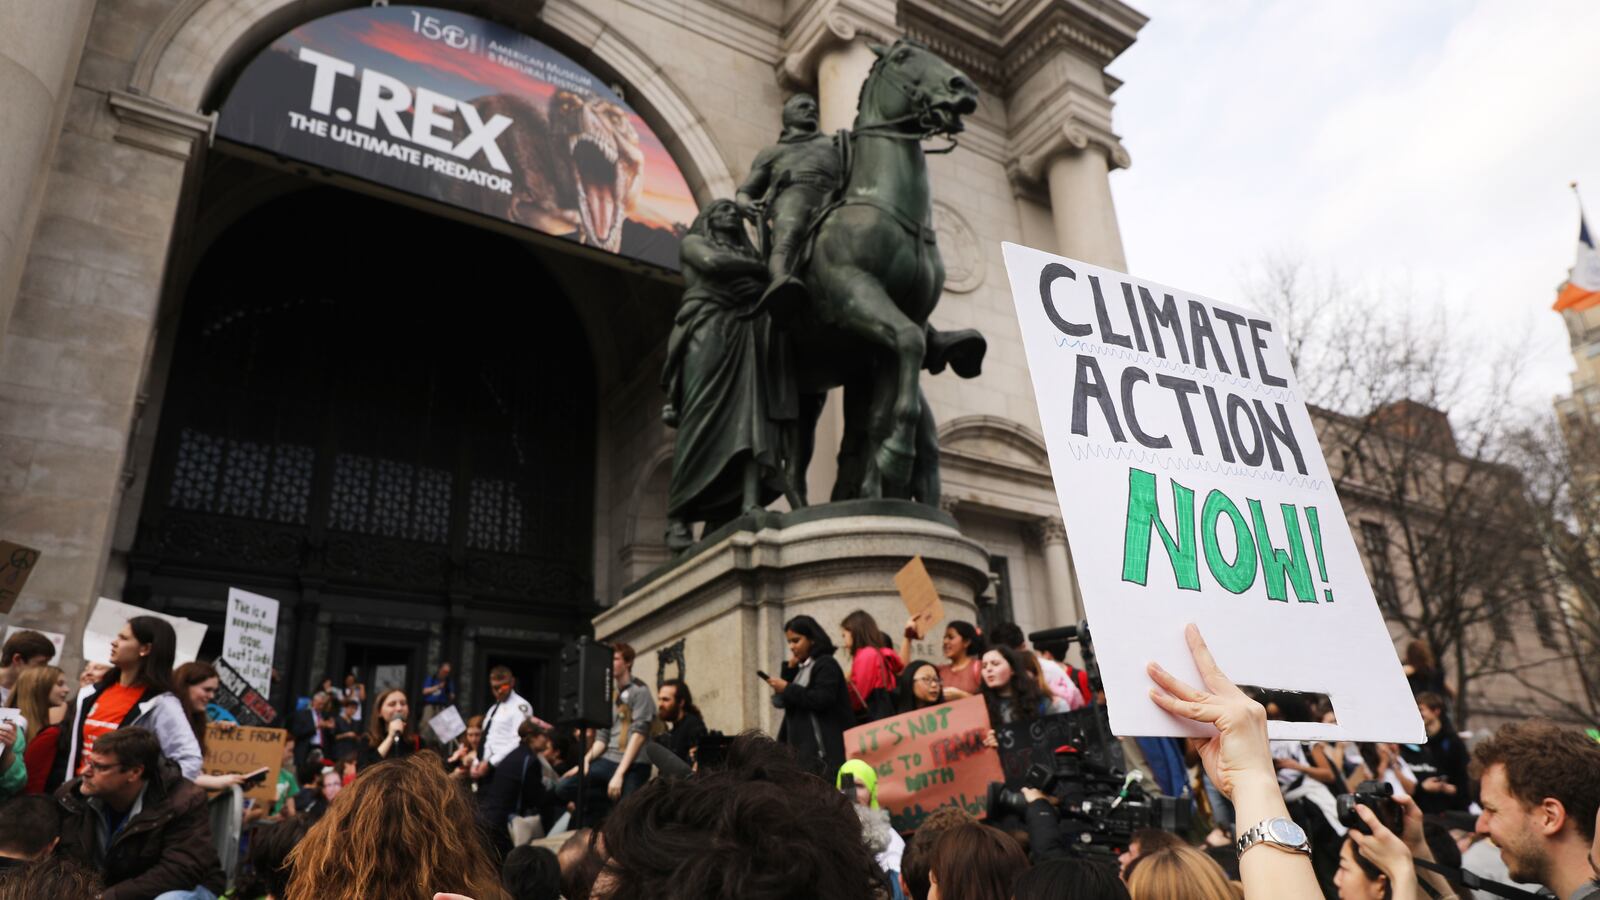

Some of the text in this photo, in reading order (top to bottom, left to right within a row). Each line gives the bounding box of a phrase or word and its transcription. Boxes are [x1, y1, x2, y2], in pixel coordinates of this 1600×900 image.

[299, 47, 514, 173] T.REX
[288, 111, 513, 195] THE ULTIMATE PREDATOR
[1038, 262, 1288, 388] CLIMATE
[1070, 354, 1309, 476] ACTION
[1121, 466, 1334, 603] NOW!
[204, 750, 266, 766] HOOL
[250, 729, 281, 744] FROM
[858, 706, 953, 754] IT'S NOT
[898, 753, 922, 770] TO
[905, 767, 955, 792] WITH
